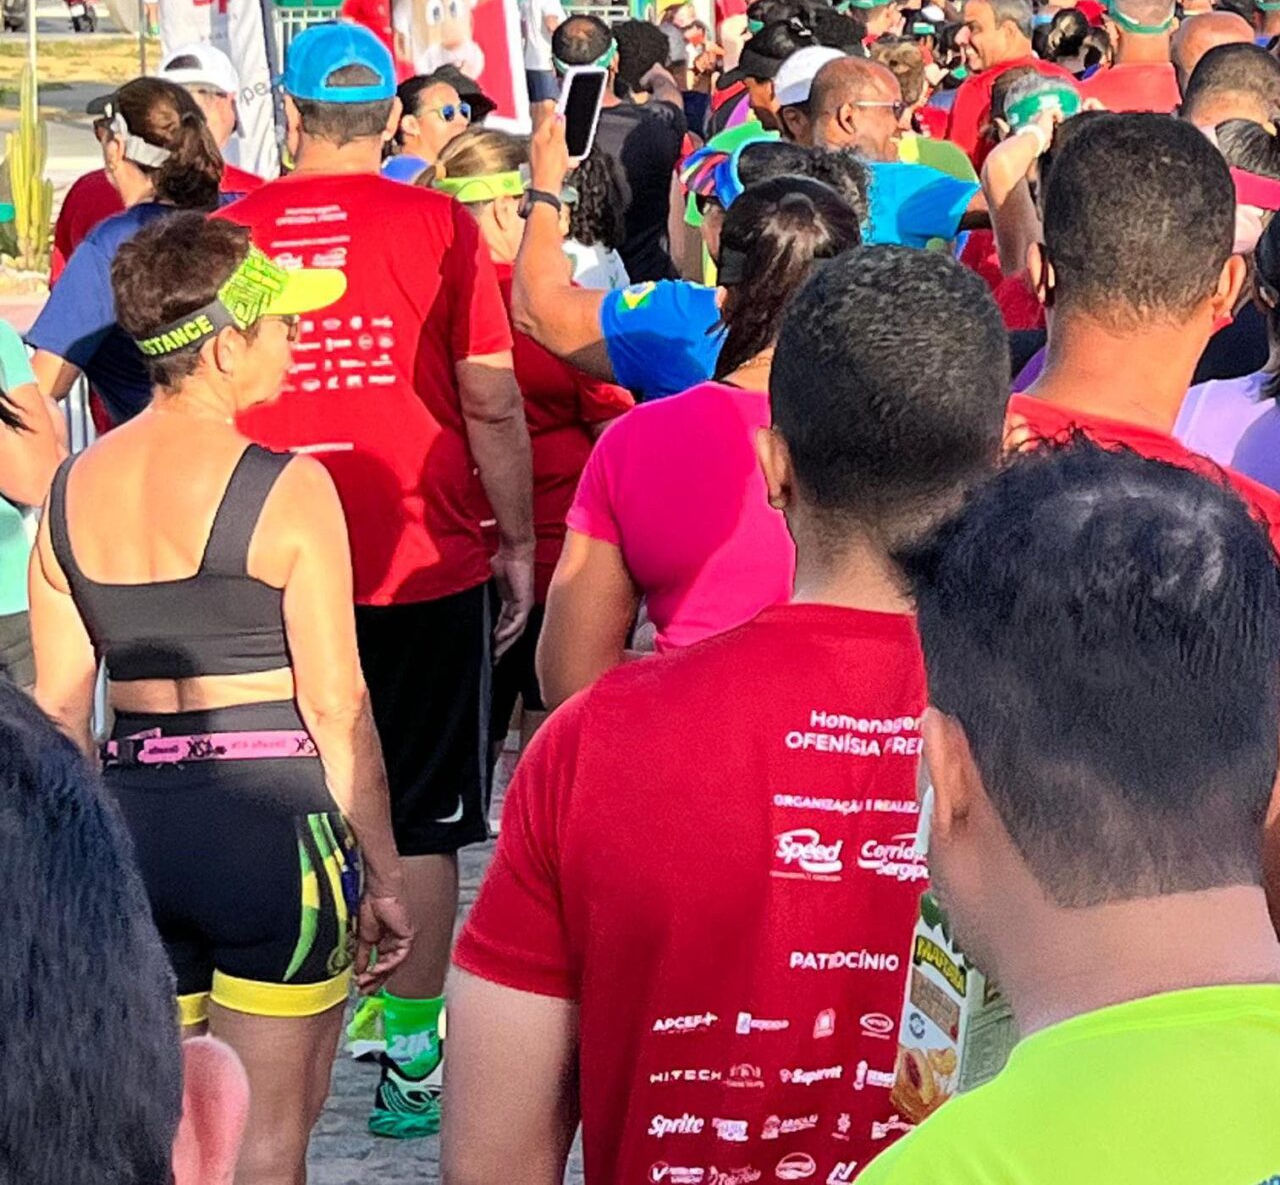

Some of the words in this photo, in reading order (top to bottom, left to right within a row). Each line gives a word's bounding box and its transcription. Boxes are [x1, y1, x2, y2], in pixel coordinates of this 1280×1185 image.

[785, 731, 881, 757] OFENÍSIA
[873, 799, 920, 813] REALIZ
[775, 834, 844, 865] Speed
[650, 1069, 722, 1084] HITECH
[648, 1113, 705, 1138] Sprite
